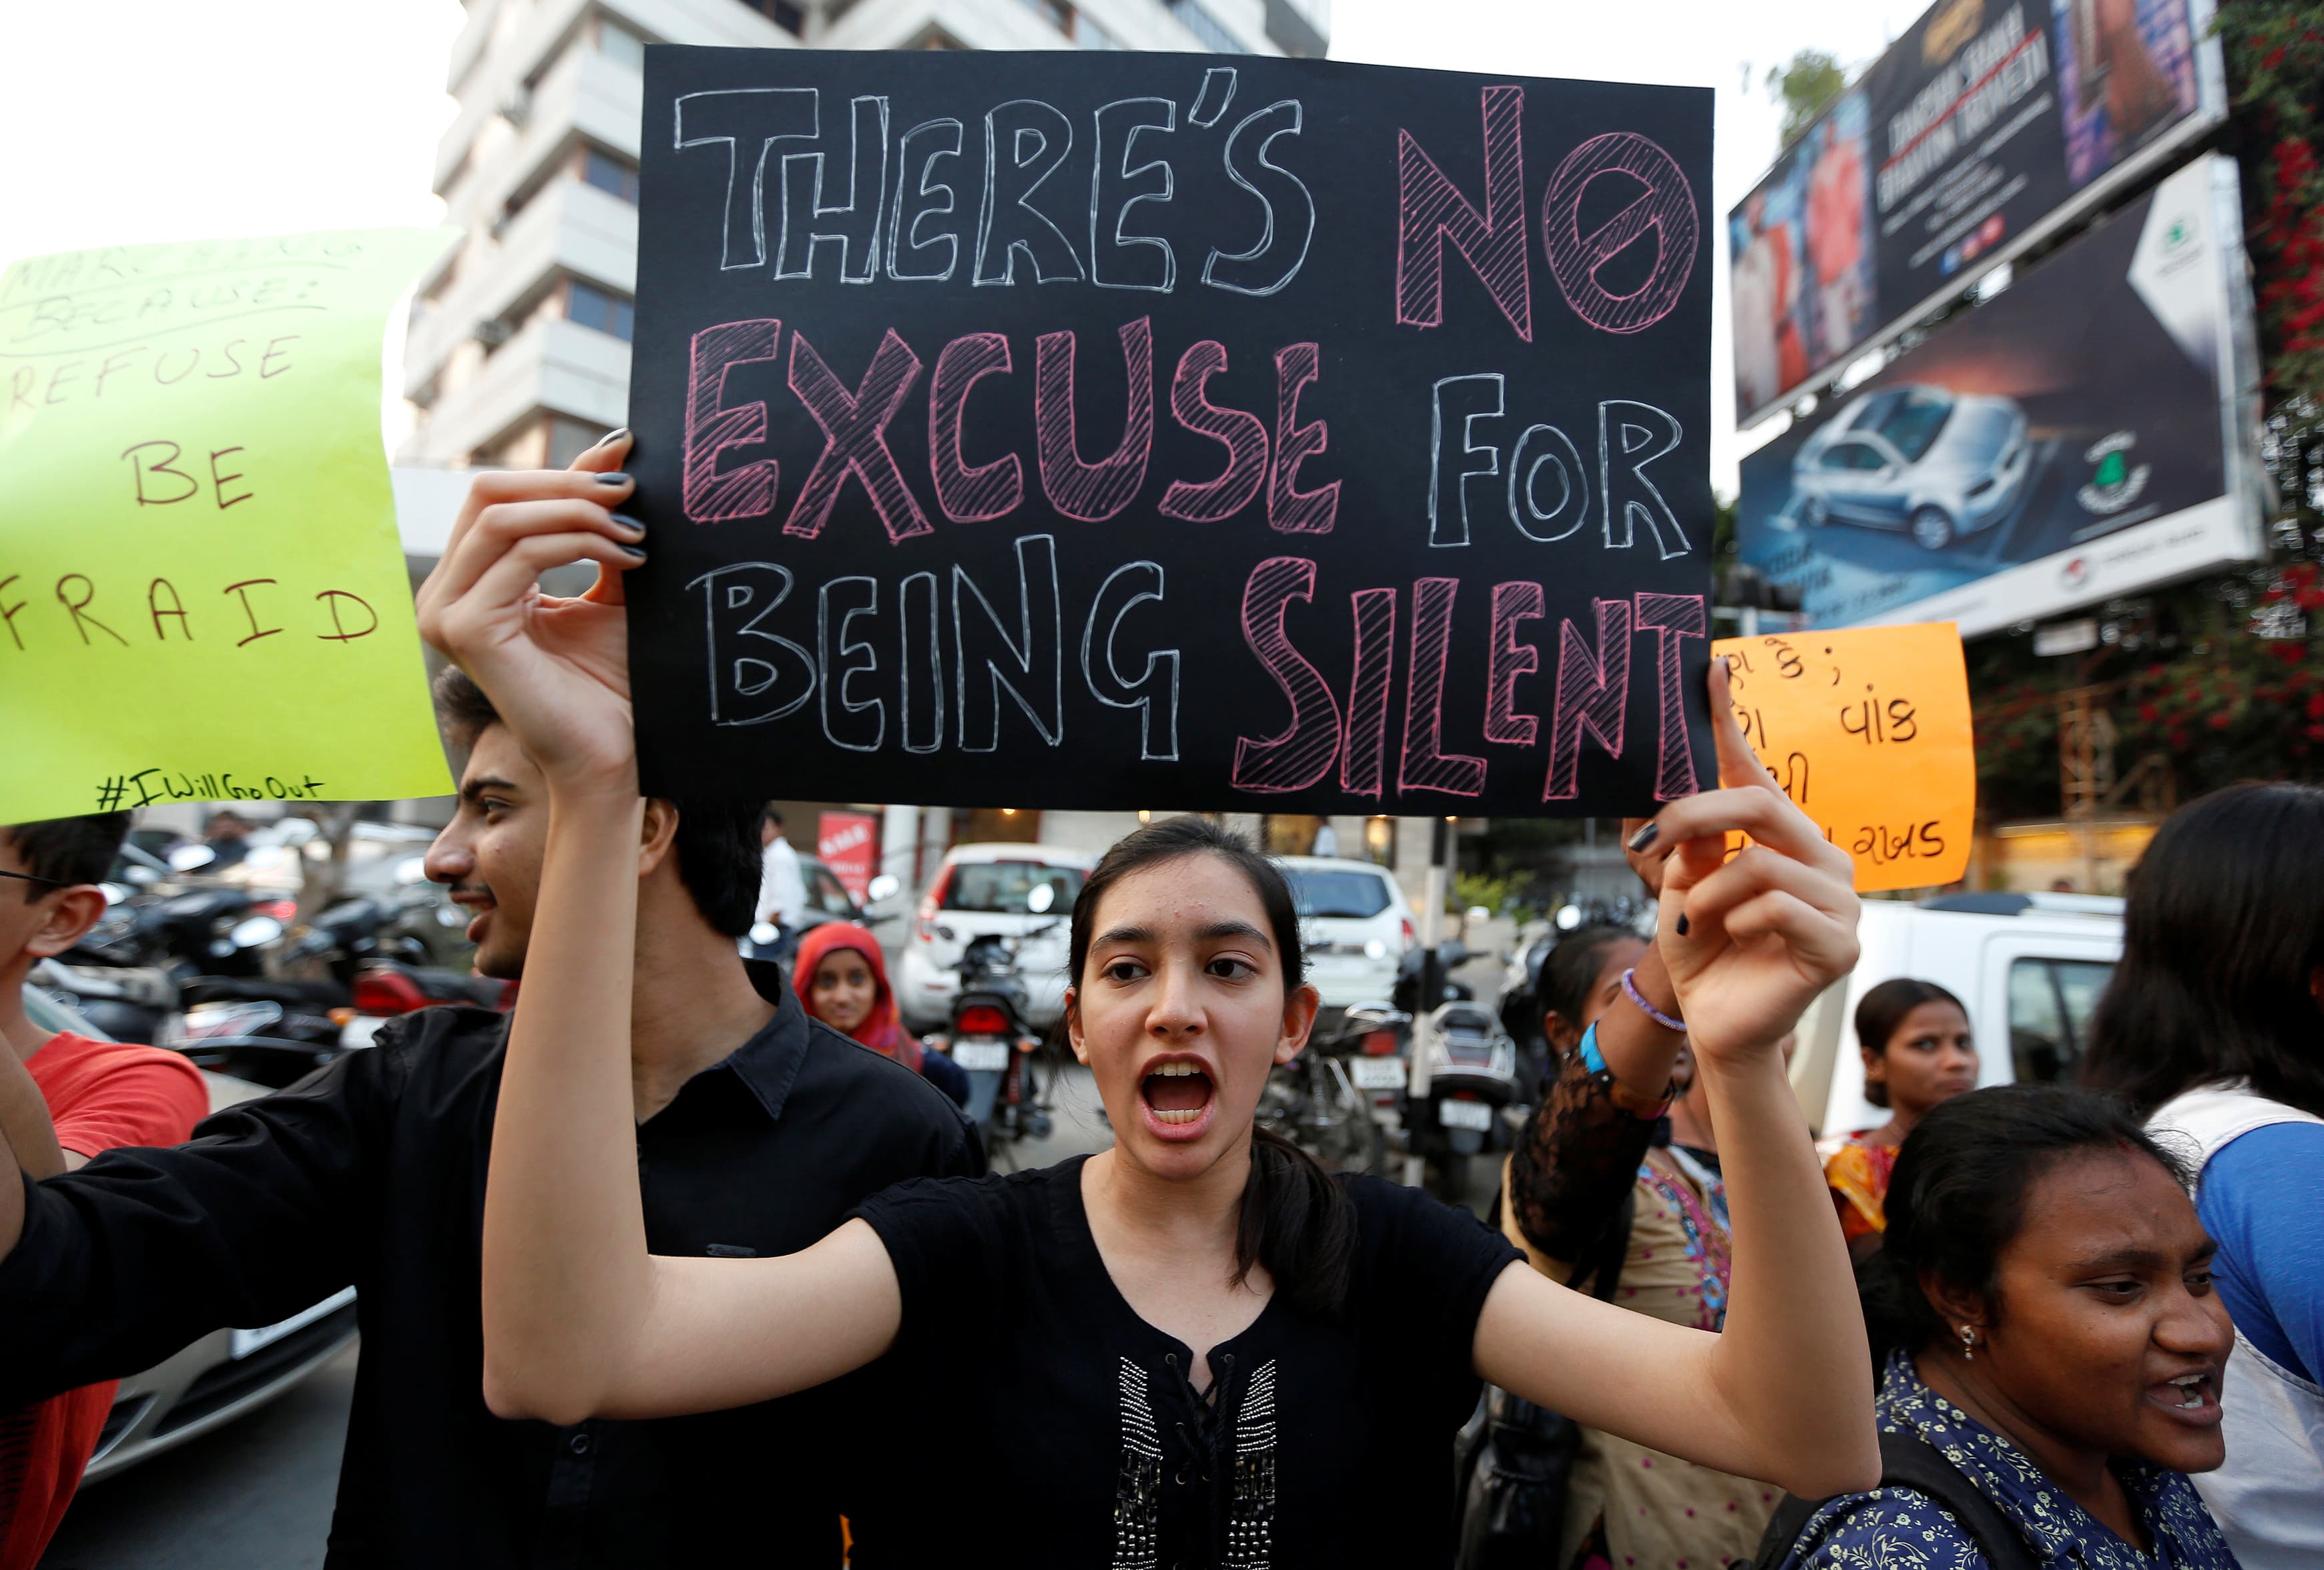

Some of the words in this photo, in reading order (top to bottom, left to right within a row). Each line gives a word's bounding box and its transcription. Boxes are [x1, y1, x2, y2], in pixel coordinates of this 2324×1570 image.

[674, 67, 1316, 296] THERE'S
[1396, 85, 1699, 343] NO
[9, 335, 302, 413] REFUSE
[121, 440, 254, 510] BE
[682, 314, 1342, 545] EXCUSE
[1427, 372, 1692, 561] FOR
[685, 533, 1179, 762] BEING
[1229, 556, 1706, 803] SILENT
